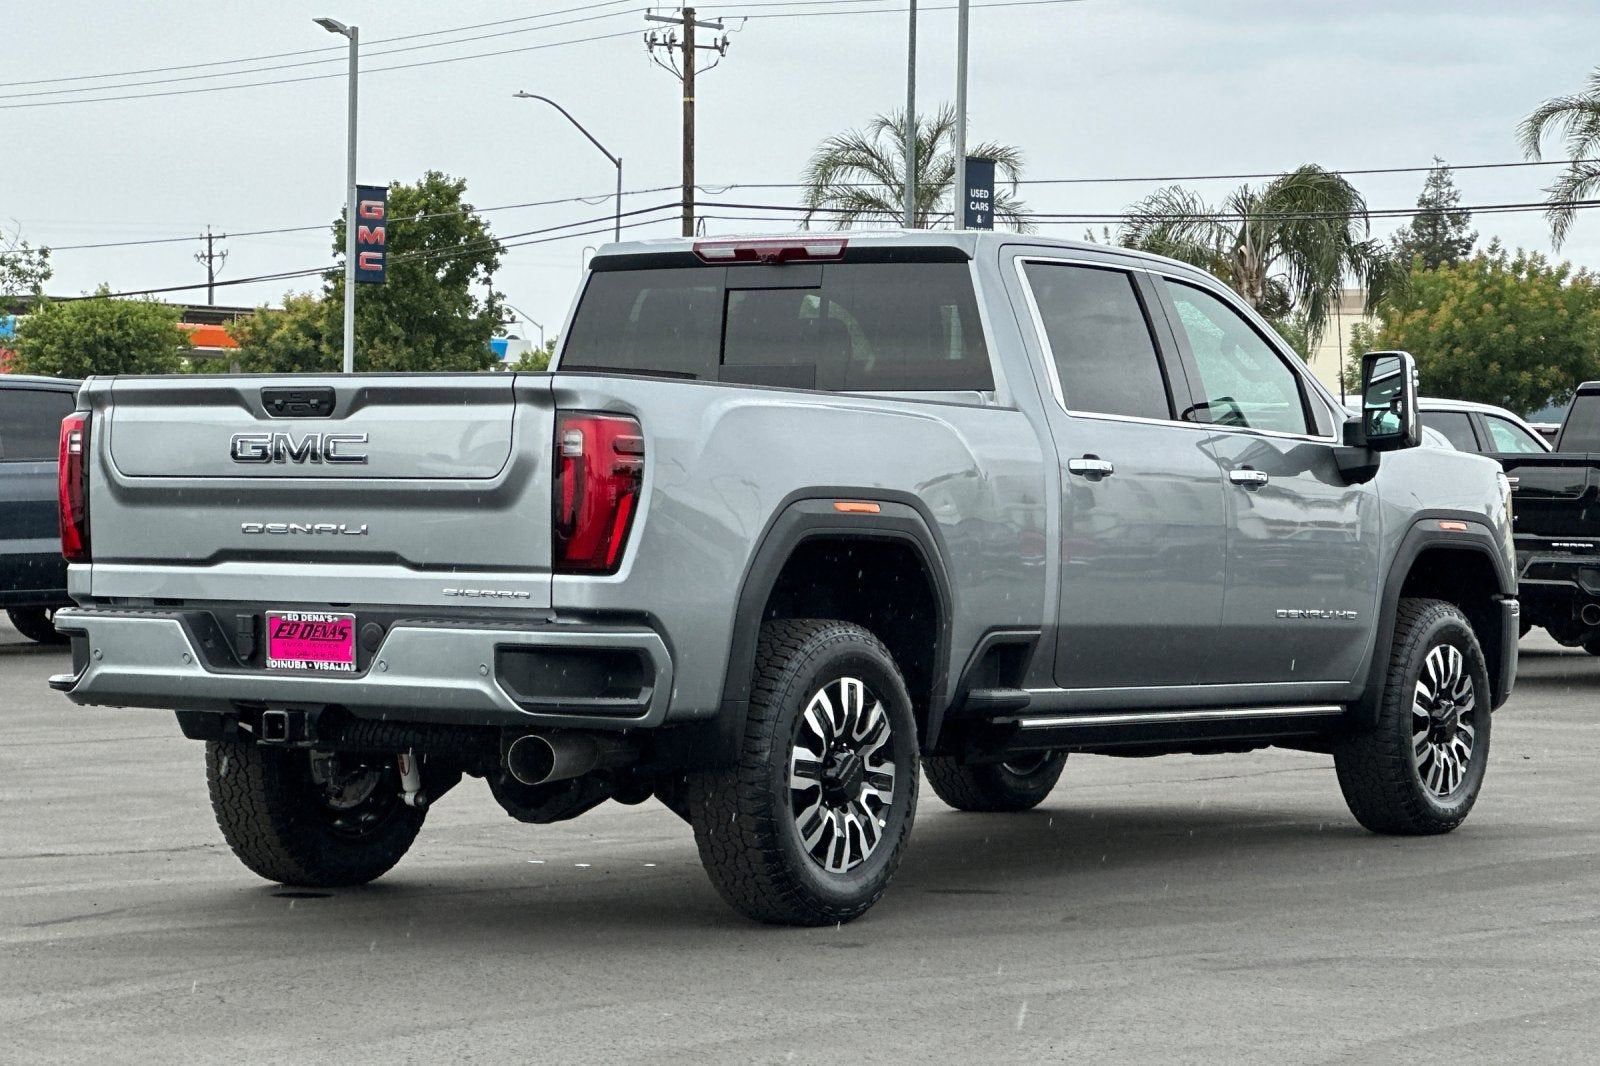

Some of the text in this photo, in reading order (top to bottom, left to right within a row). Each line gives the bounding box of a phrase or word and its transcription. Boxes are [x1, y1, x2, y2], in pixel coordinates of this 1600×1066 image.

[970, 188, 989, 198] USED
[970, 201, 989, 211] CARS
[976, 214, 982, 223] &
[358, 200, 385, 271] GMC
[230, 432, 368, 464] GMC
[241, 522, 368, 535] DENALI
[442, 588, 530, 599] SIERRA
[287, 613, 333, 622] ED DENA'S
[1276, 609, 1357, 619] DENALI HD
[273, 623, 300, 639] ED
[271, 660, 350, 671] DINUBA VISALIA
